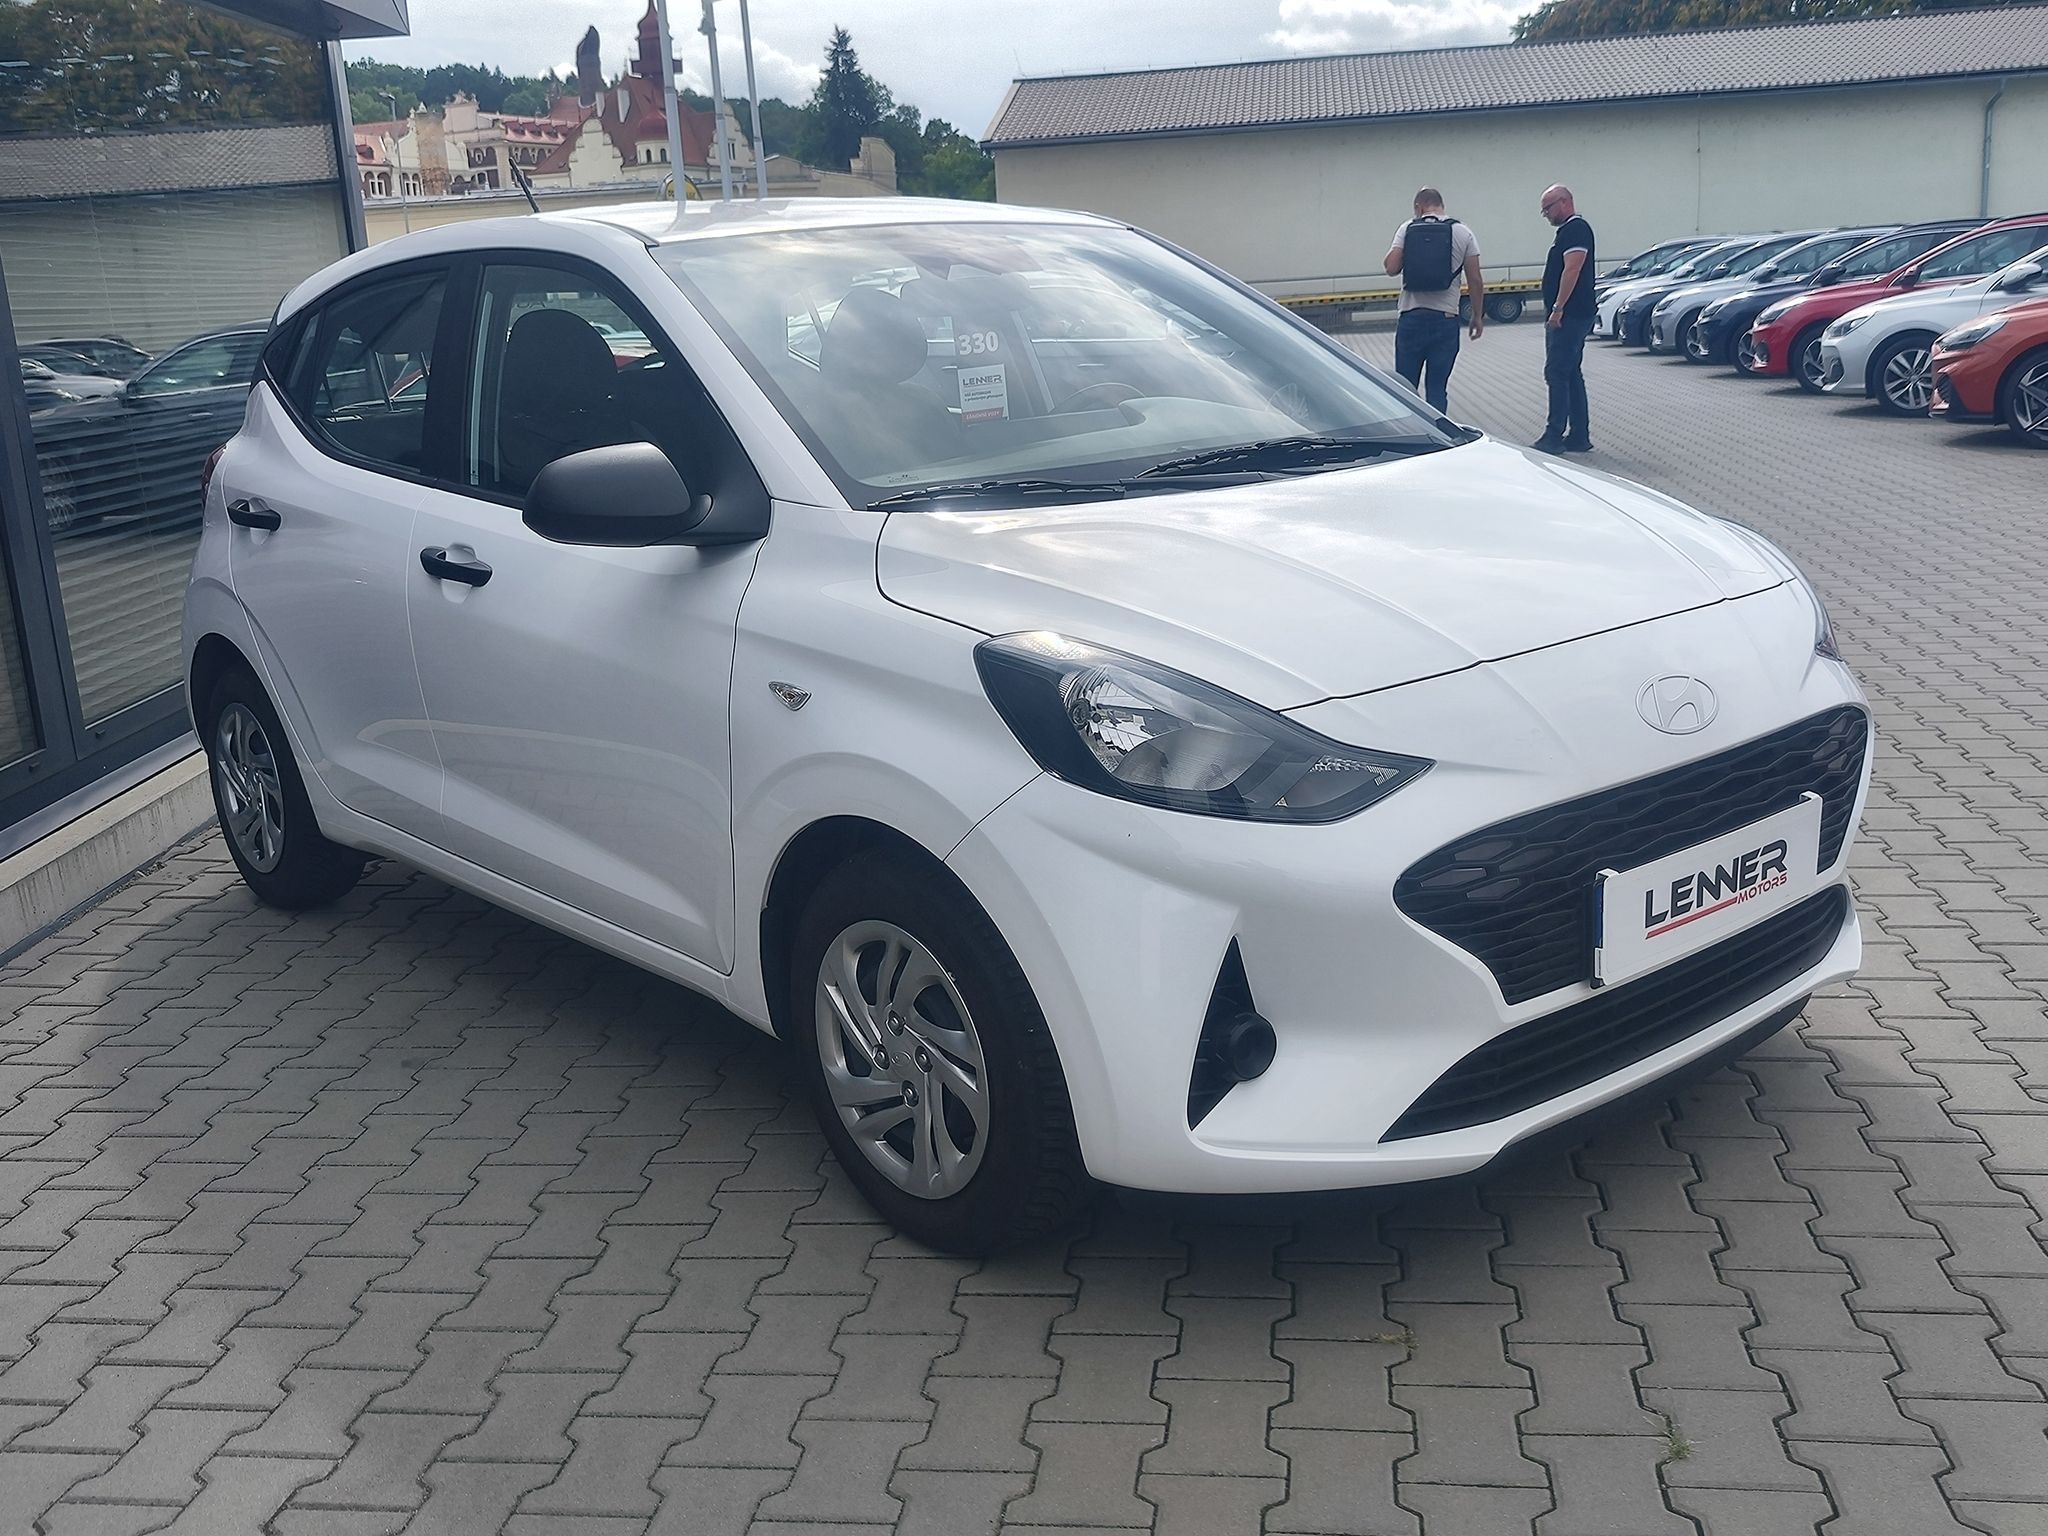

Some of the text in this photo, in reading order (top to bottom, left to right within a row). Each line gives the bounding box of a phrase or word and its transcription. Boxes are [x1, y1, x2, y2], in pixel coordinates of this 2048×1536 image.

[958, 331, 999, 356] 330
[962, 374, 1002, 386] LENNER
[1644, 838, 1788, 929] LENNER
[1737, 873, 1788, 905] MOTORS
